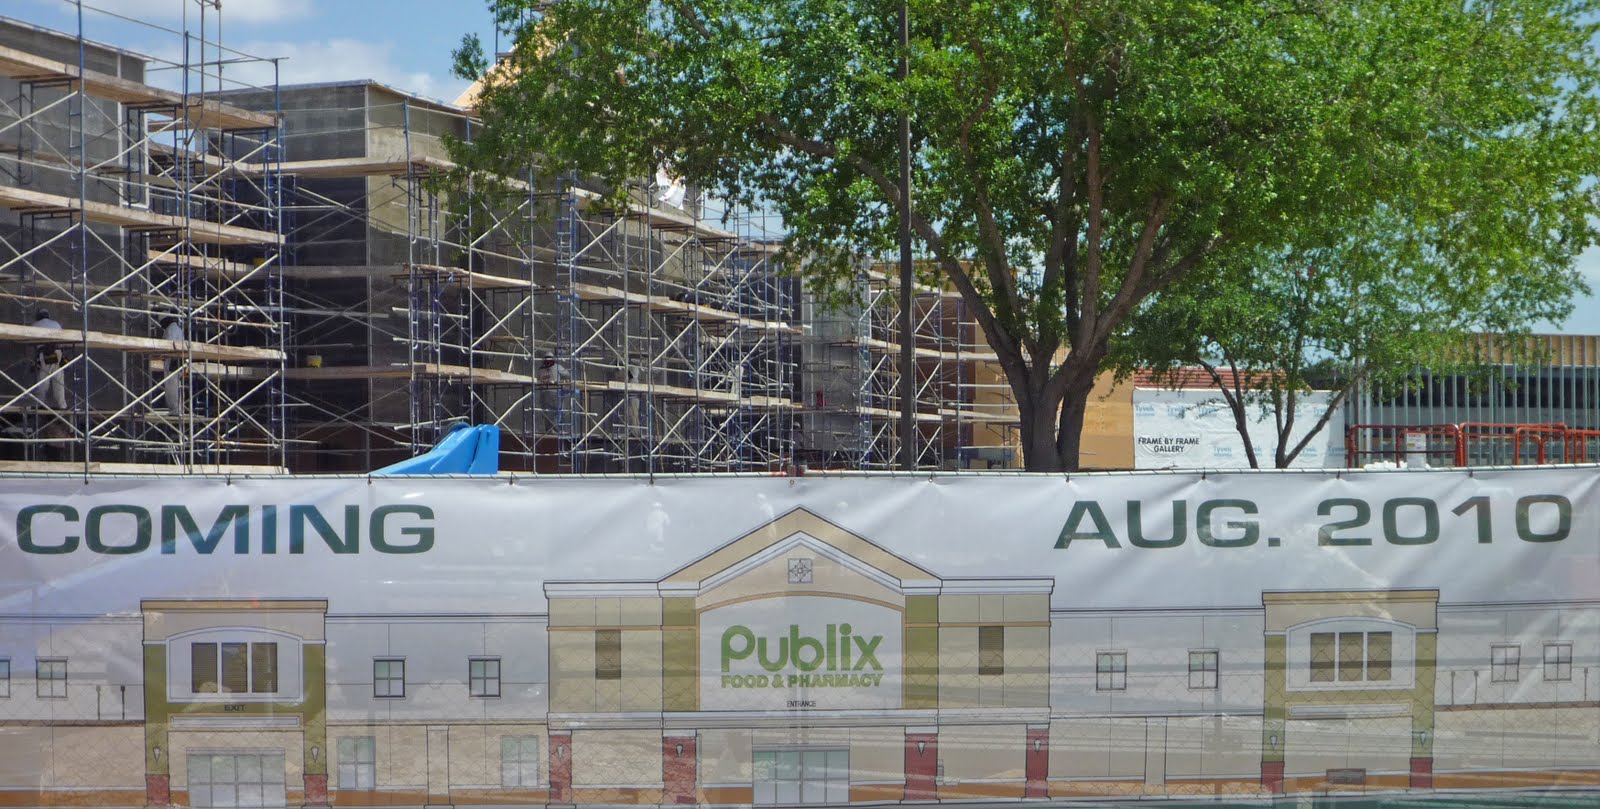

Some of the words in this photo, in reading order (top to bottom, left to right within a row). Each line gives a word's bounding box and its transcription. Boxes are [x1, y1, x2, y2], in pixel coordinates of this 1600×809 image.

[1138, 437, 1163, 445] FRAME
[1164, 437, 1174, 445] BY
[1175, 437, 1200, 445] FRAME
[1153, 445, 1185, 453] GALLERY
[1054, 498, 1281, 550] AUG.
[1317, 494, 1573, 546] 2010
[16, 504, 436, 555] COMING
[721, 623, 883, 672] Publix
[721, 675, 769, 688] FOOD
[772, 674, 785, 688] &
[788, 674, 884, 688] PHARMACY
[787, 700, 816, 708] ENTRANCE
